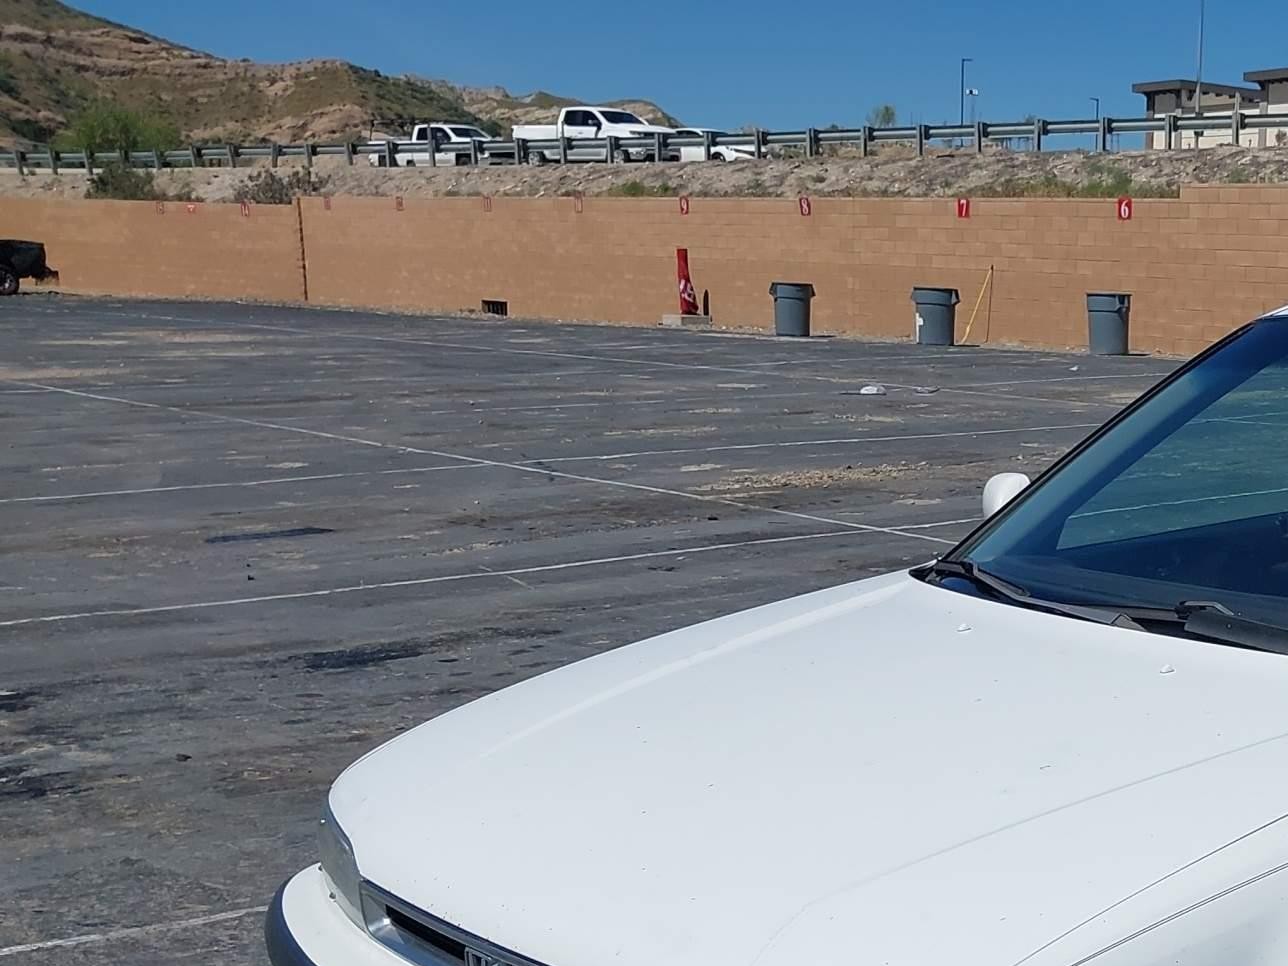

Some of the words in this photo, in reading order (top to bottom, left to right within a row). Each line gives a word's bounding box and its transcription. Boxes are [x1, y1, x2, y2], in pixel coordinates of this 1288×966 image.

[801, 199, 808, 215] 8
[960, 199, 967, 217] 7
[1121, 199, 1129, 218] 6
